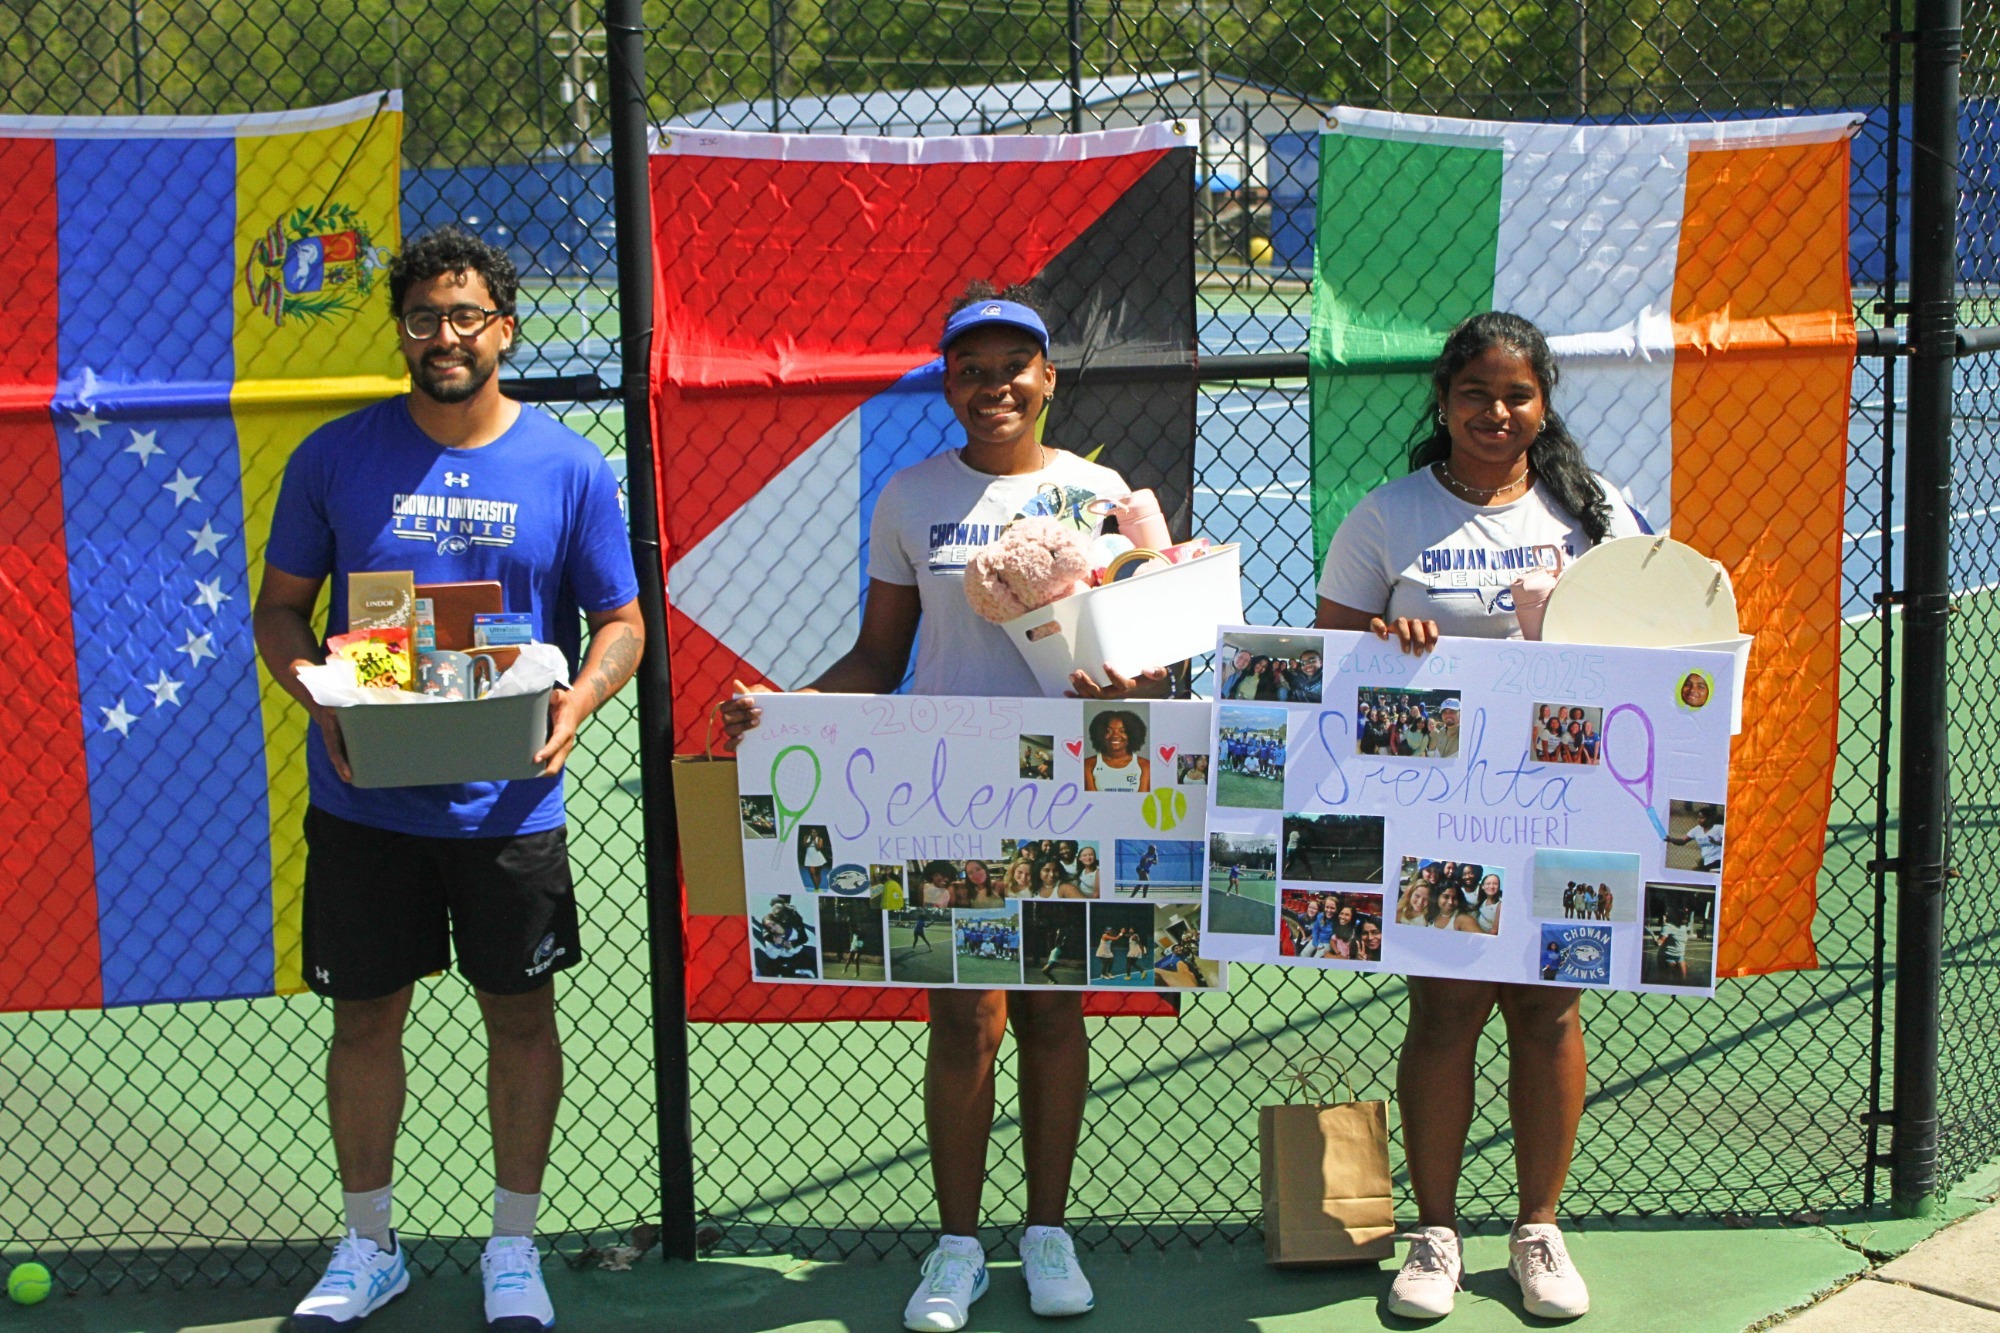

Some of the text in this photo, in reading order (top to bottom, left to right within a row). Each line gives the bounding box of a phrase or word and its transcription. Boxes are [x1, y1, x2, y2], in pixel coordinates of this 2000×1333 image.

[392, 494, 518, 524] CHOWAN UNIVERSITY
[392, 515, 516, 538] TENNIS
[929, 523, 990, 548] CHOWAN
[1421, 548, 1486, 573] CHOWAN
[1338, 648, 1606, 701] CLASS OF 2025
[761, 723, 811, 741] CLASS
[861, 698, 1024, 739] 2025
[1315, 707, 1581, 813] Sreshta
[834, 737, 1094, 841] Selene
[878, 833, 983, 861] KENTISH
[1563, 927, 1610, 944] CHOWAN
[1565, 964, 1605, 979] HAWKS
